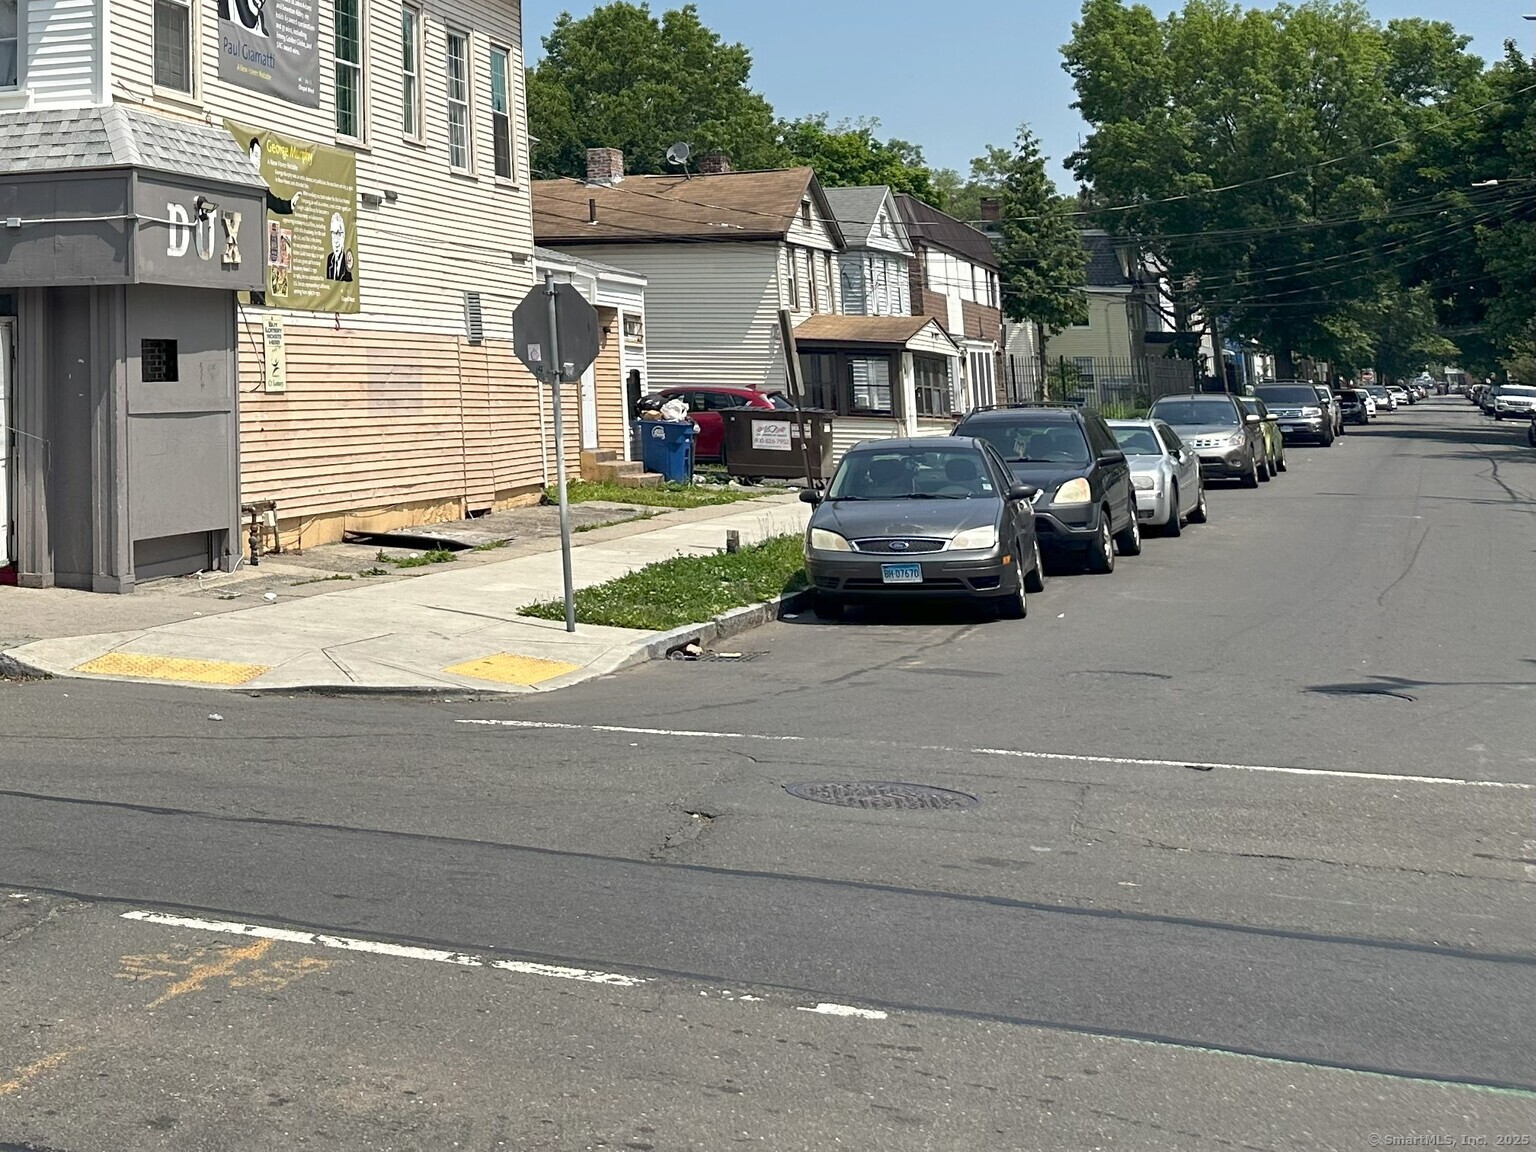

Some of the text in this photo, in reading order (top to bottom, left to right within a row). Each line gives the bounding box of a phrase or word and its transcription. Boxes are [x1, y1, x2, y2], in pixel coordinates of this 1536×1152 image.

[223, 36, 275, 69] Paul Giamatti
[266, 139, 313, 167] George Murphy
[167, 201, 242, 263] DUX
